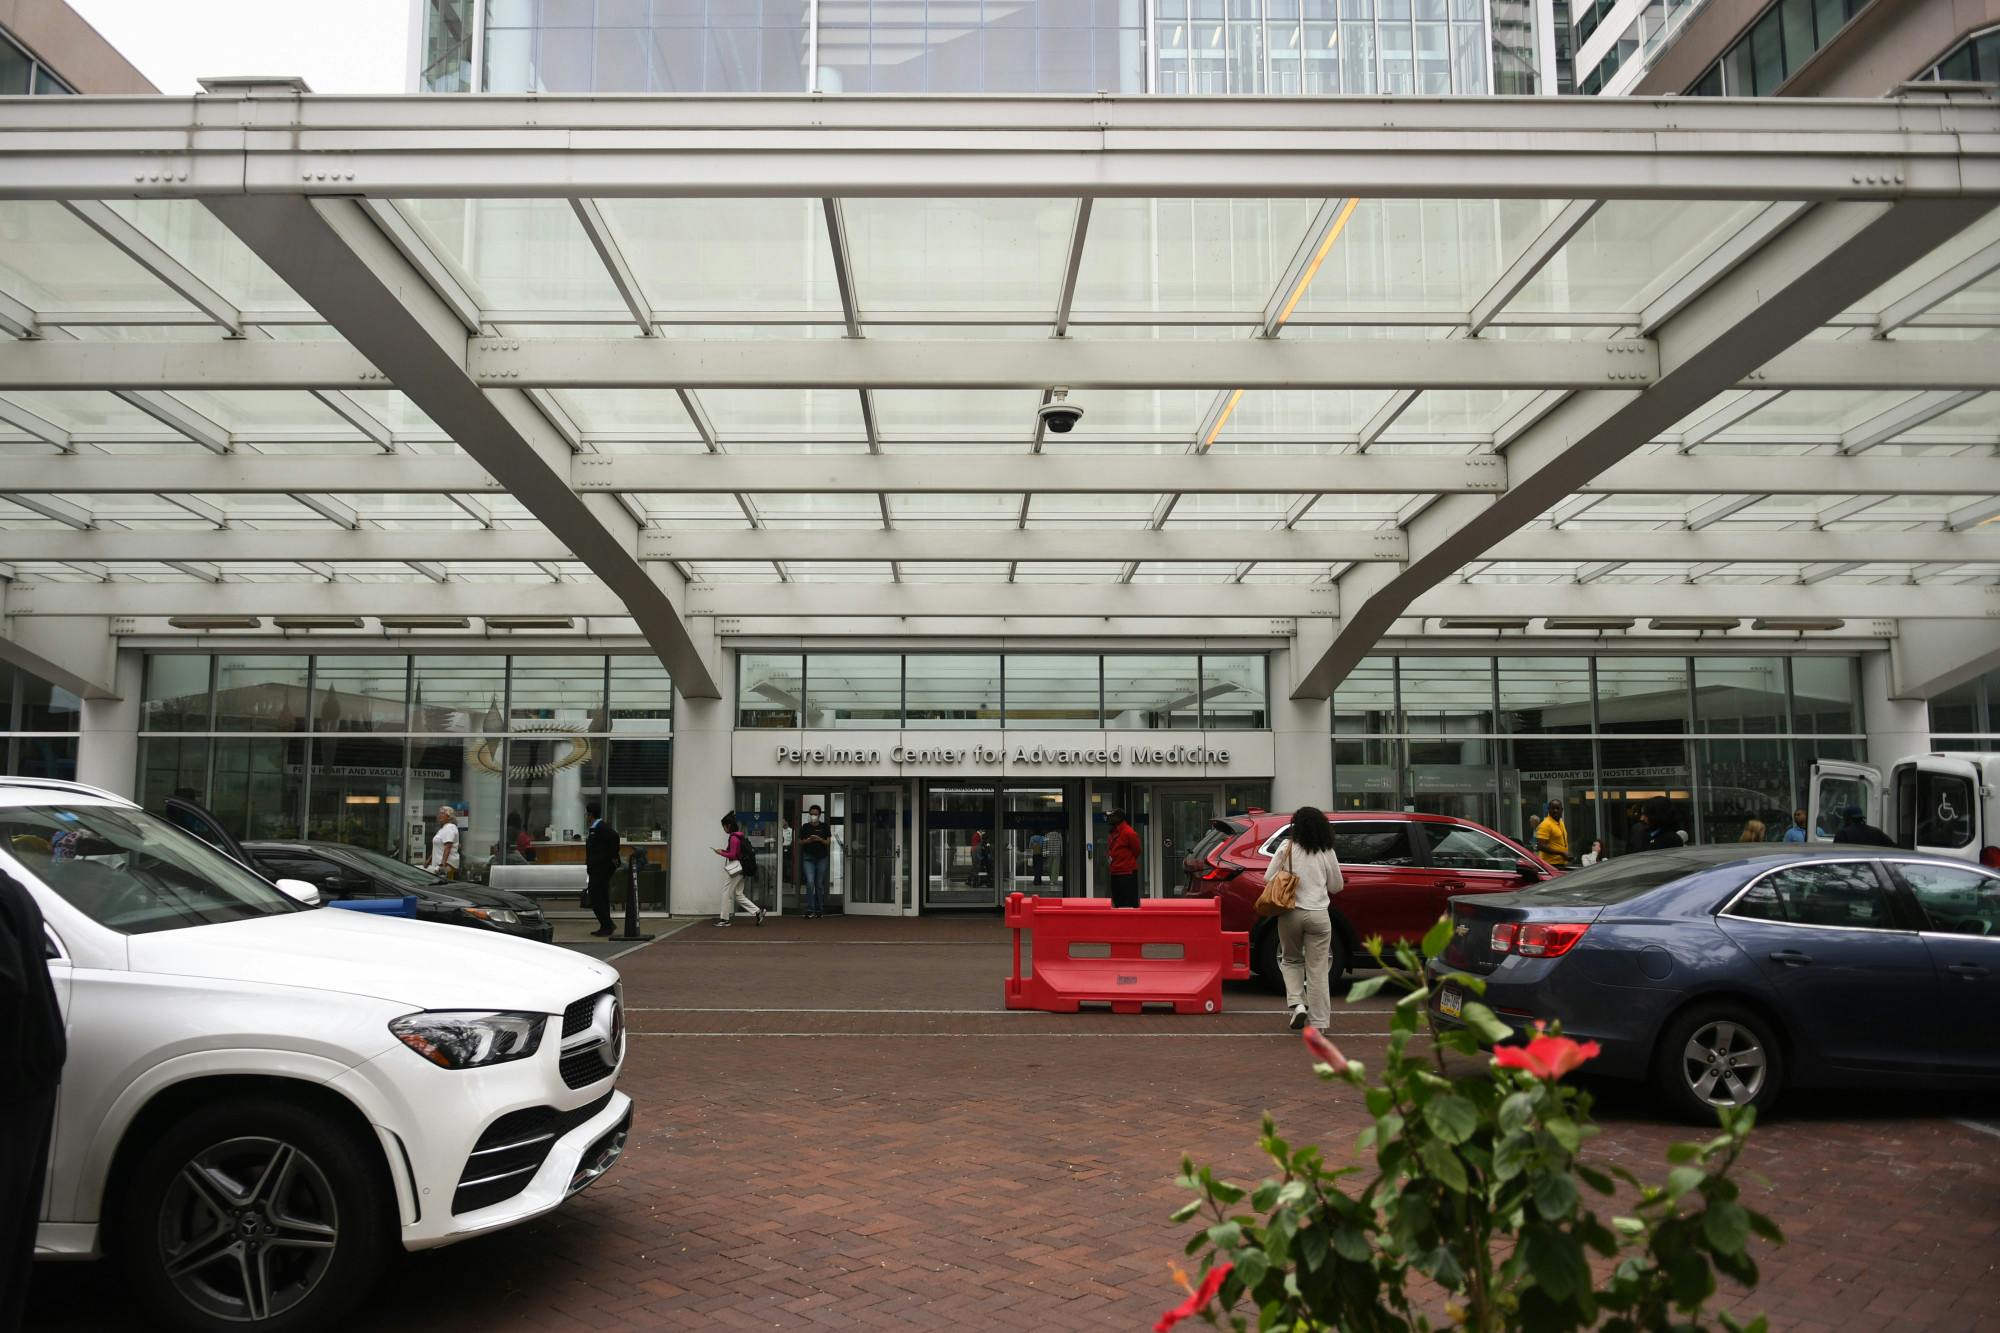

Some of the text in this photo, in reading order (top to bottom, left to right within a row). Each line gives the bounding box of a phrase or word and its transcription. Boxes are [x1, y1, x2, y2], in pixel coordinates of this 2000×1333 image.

[775, 744, 1231, 764] Perelman Center for Advanced Medicine
[292, 766, 446, 778] PEN HART AND VASCUL TESTING
[1529, 767, 1676, 780] PULMONARY DIANOSTIC SERVICES
